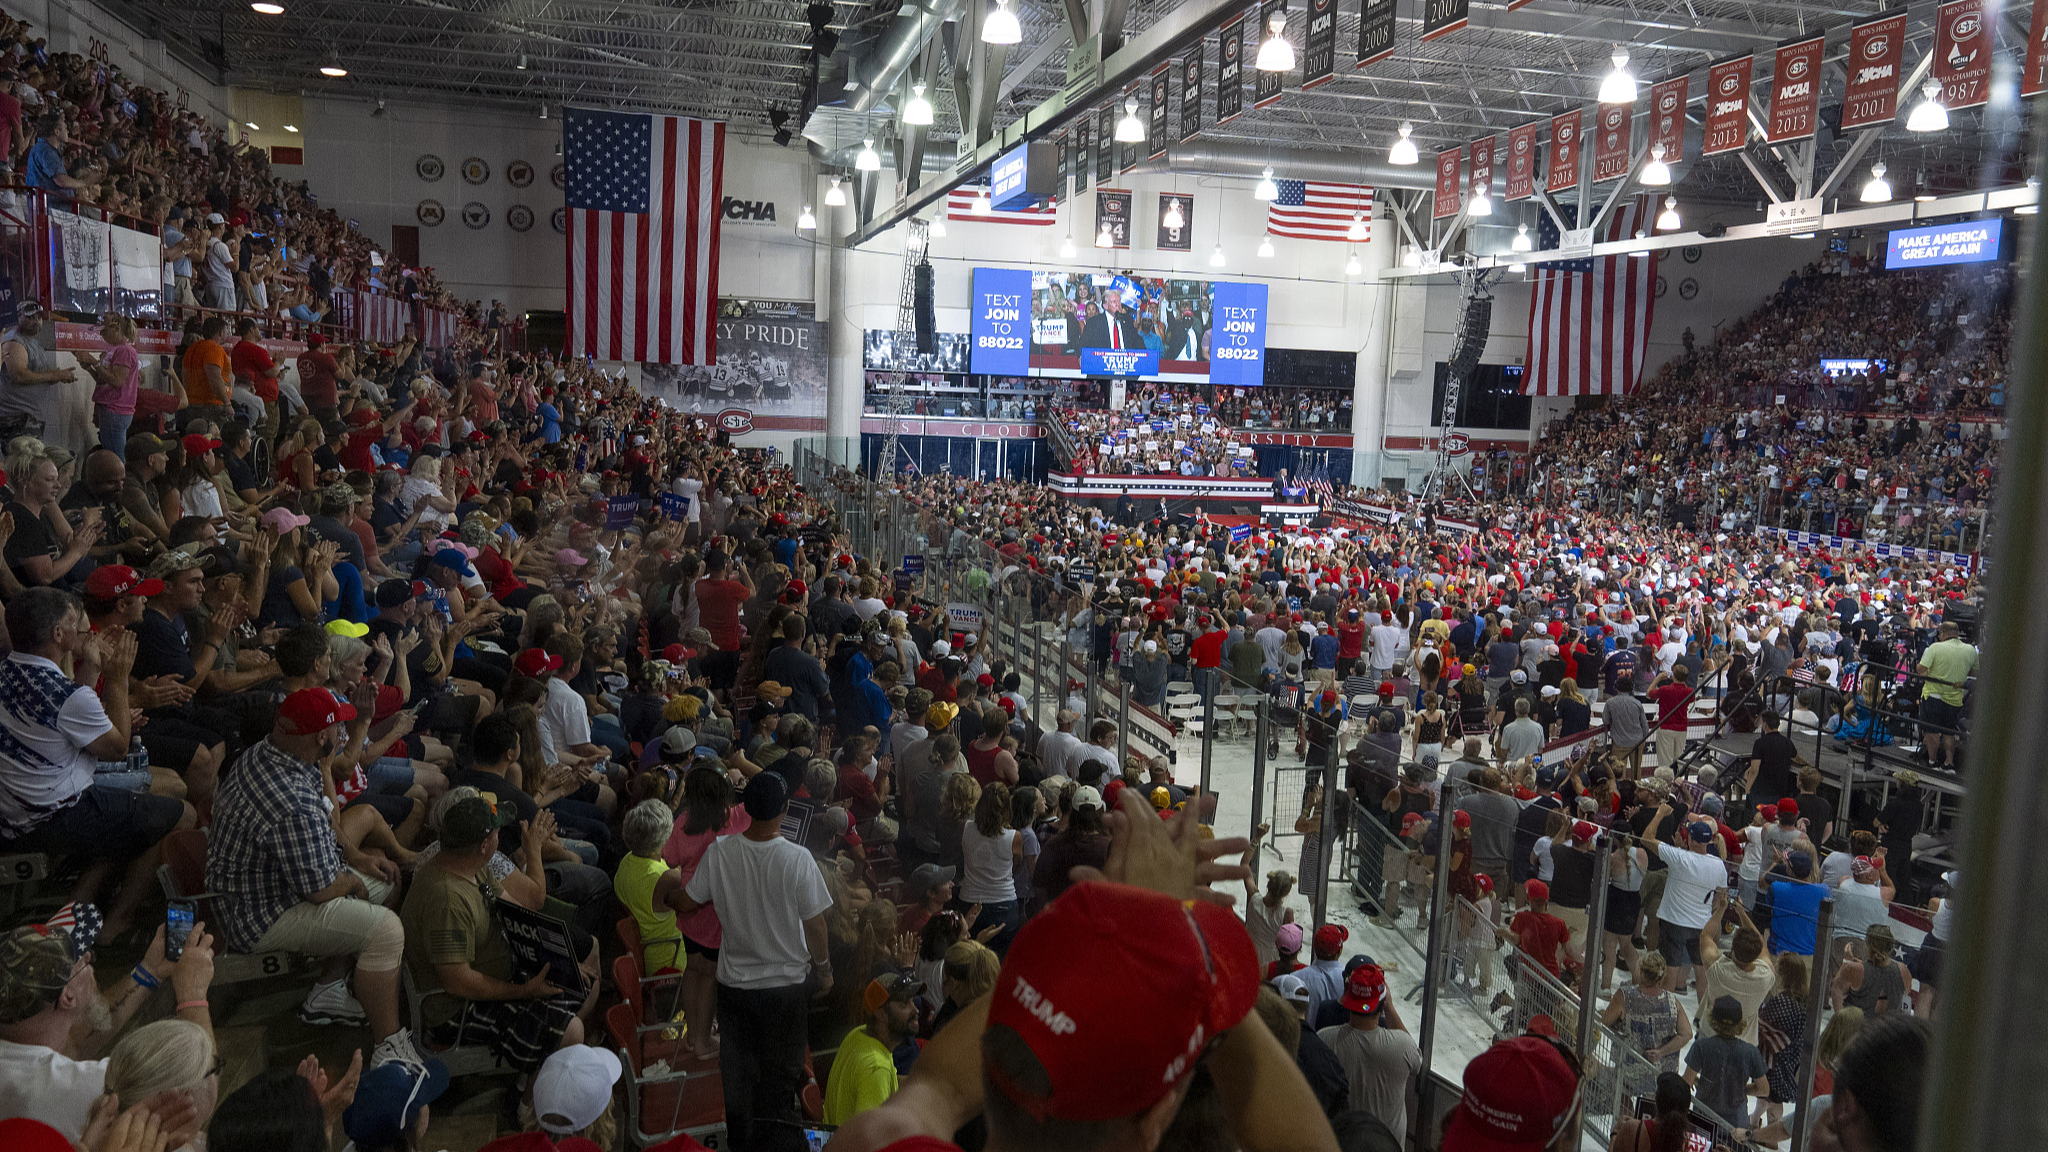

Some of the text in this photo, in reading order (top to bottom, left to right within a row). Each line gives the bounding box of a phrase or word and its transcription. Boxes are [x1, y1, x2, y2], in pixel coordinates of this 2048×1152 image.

[1944, 6, 1964, 16] MEN'S
[1311, 13, 1331, 35] NCAA
[1858, 20, 1901, 37] MEN'S HOCKEY
[1365, 25, 1389, 51] 2008
[89, 35, 109, 65] 206
[1799, 43, 1819, 54] HOCKEY
[1308, 51, 1329, 75] 2010
[1952, 68, 1987, 82] CHAMPION
[177, 87, 190, 109] 207
[1780, 81, 1810, 100] NCAA
[1847, 87, 1895, 102] PLAYOFF CHAMPION
[1940, 80, 1979, 103] 1987
[1852, 98, 1885, 119] 2001
[1777, 114, 1806, 134] 2013
[1711, 128, 1738, 147] 2013
[1473, 166, 1489, 181] NCAA
[1600, 159, 1621, 174] 2016
[1553, 172, 1573, 187] 2018
[1510, 181, 1528, 195] 2019
[1438, 200, 1454, 213] 2023
[1898, 229, 1988, 249] MAKE AMERICA
[1902, 242, 1981, 260] GREAT AGAIN
[753, 301, 772, 309] YOU
[984, 294, 1021, 307] TEXT
[984, 308, 1019, 321] JOIN
[1223, 307, 1257, 319] TEXT
[992, 322, 1011, 335] TO
[1223, 321, 1255, 334] JOIN
[745, 323, 810, 350] PRIDE
[979, 336, 1023, 350] 88022
[1230, 335, 1247, 347] TO
[1217, 347, 1259, 361] 88022
[713, 368, 727, 381] 13
[962, 424, 1048, 438] CLOUD
[1250, 434, 1319, 447] RSITY
[611, 501, 637, 513] TRUMP
[1232, 526, 1250, 536] TRUMP
[950, 608, 983, 617] TRUMP
[953, 615, 980, 623] VANCE
[15, 861, 33, 880] 9
[503, 916, 541, 943] BACK
[511, 940, 537, 962] THE
[262, 956, 280, 974] 8
[1012, 976, 1077, 1035] TRUMP
[1480, 1103, 1522, 1123] AMERICA
[1487, 1116, 1518, 1132] AGAIN
[704, 1135, 718, 1150] 6
